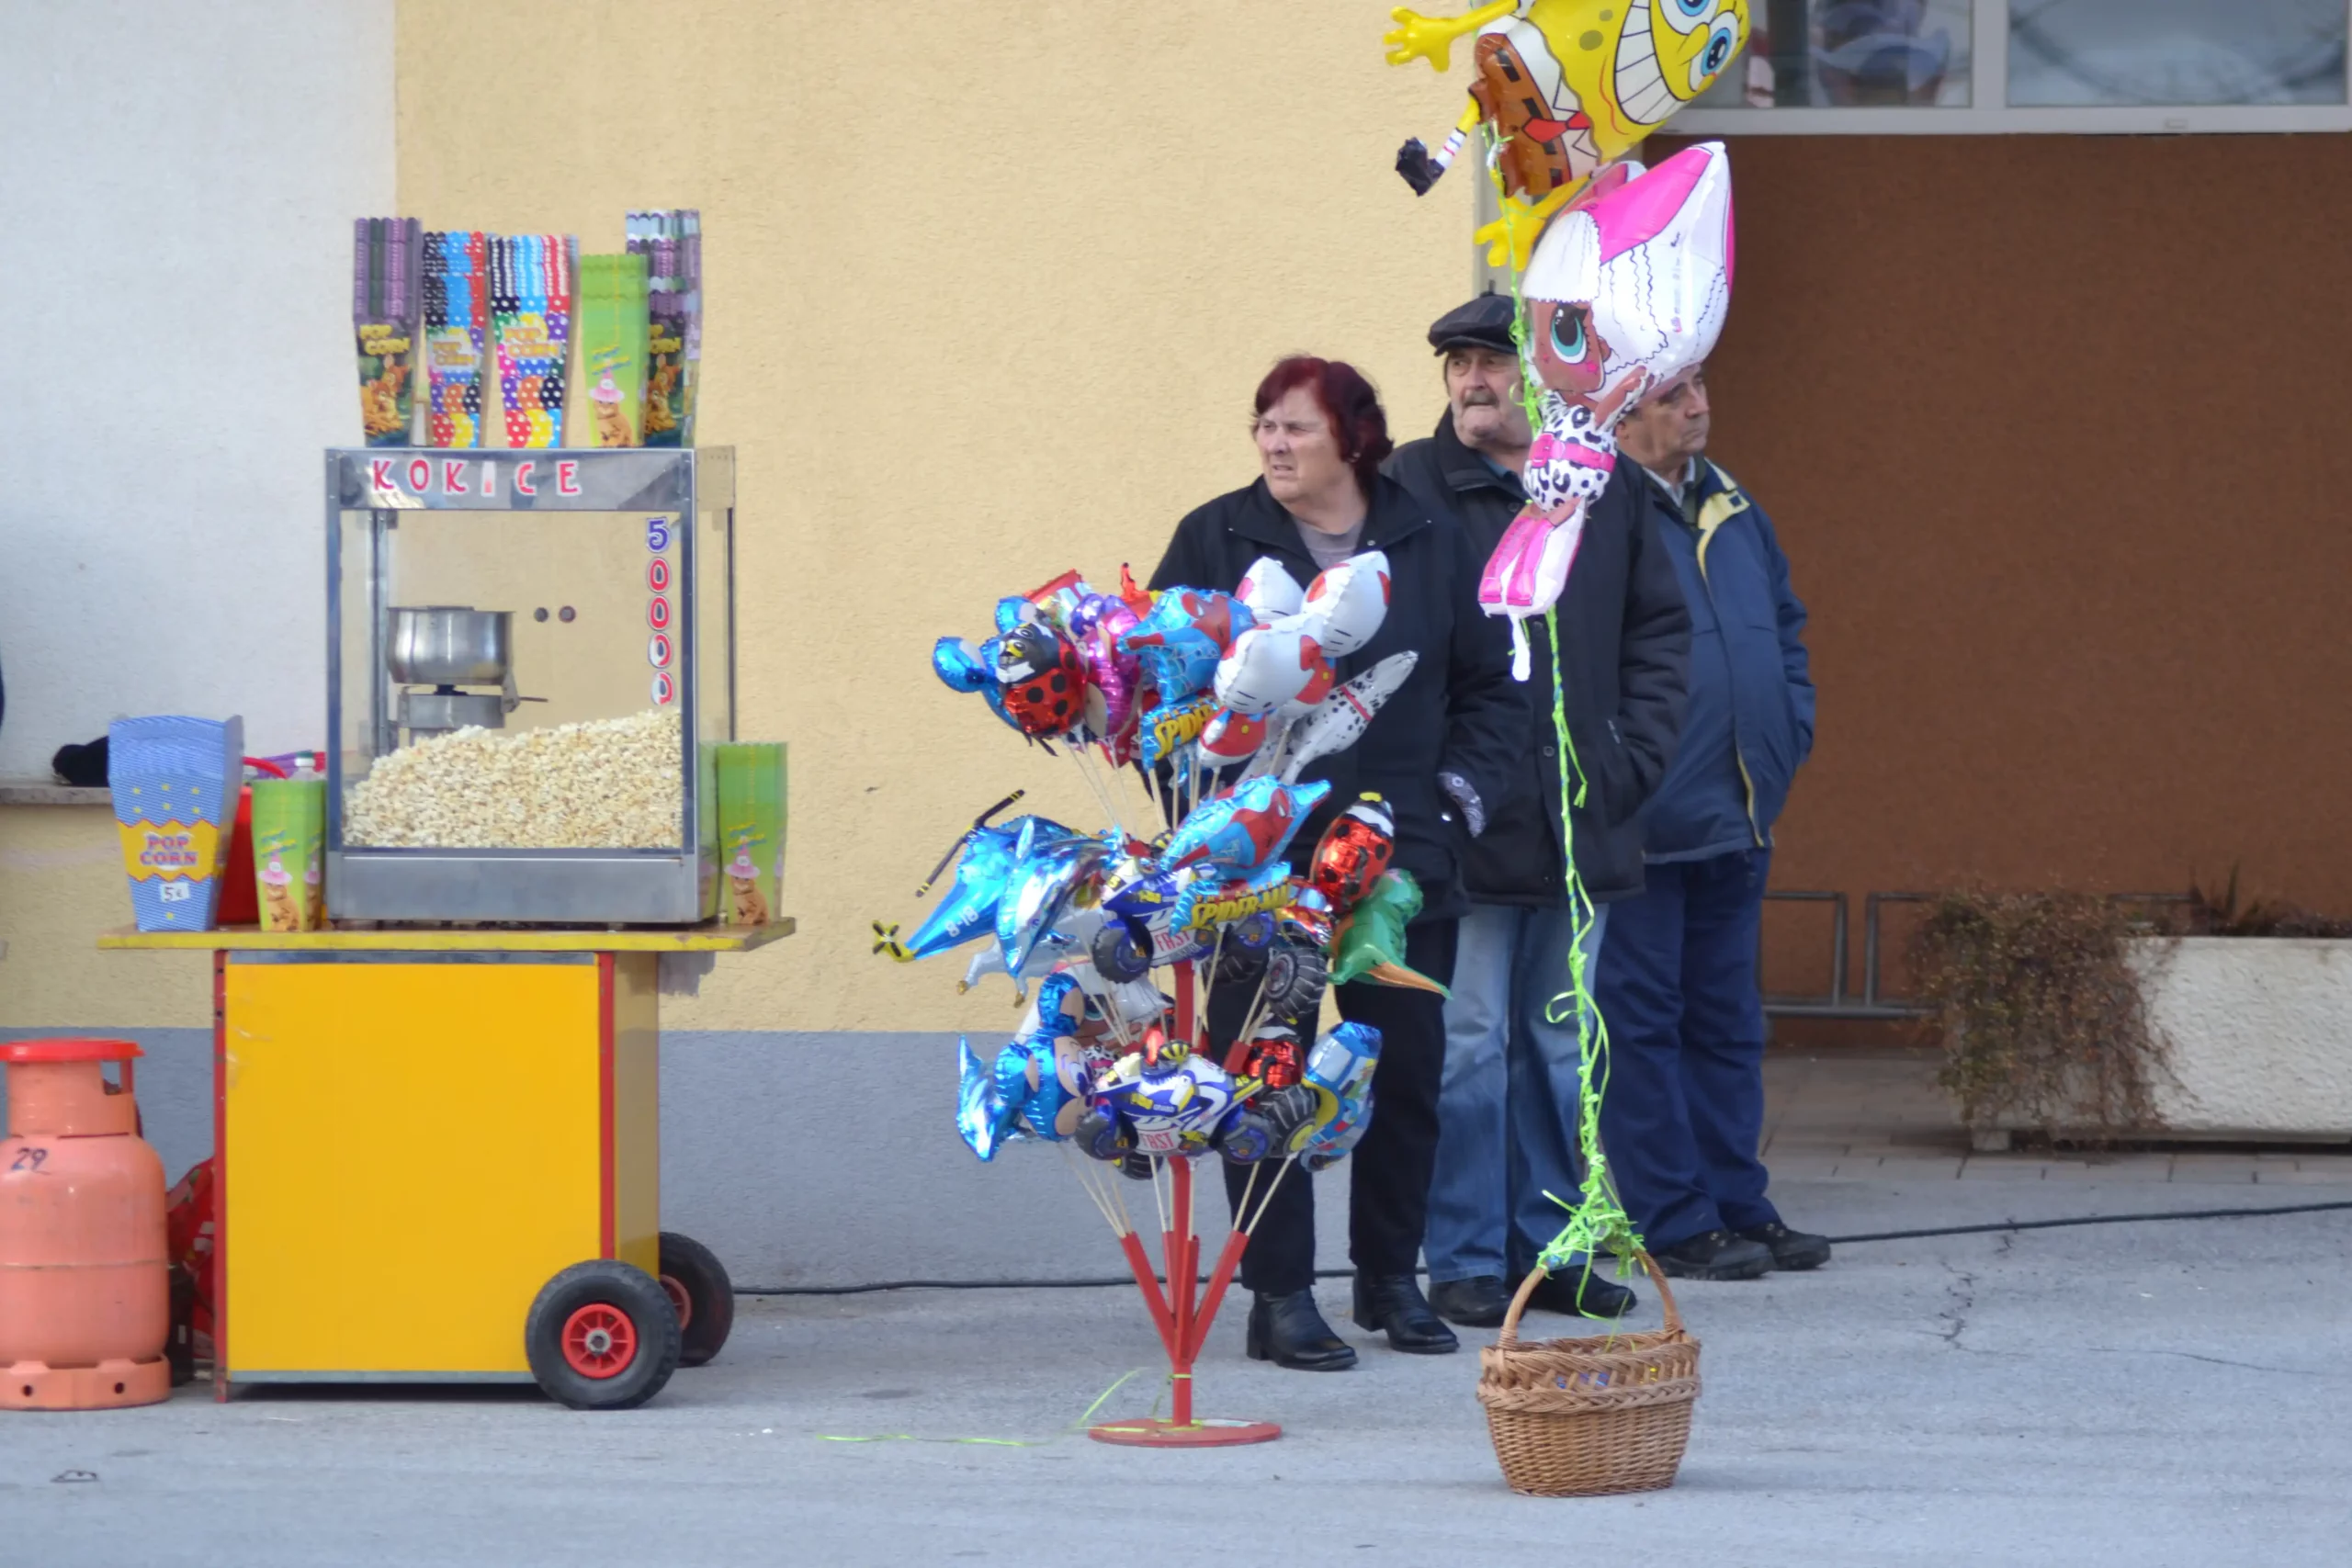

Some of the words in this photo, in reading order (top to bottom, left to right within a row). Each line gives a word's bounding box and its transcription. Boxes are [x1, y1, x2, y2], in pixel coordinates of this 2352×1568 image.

[371, 458, 580, 495] KOKICE
[146, 834, 190, 850] POP
[140, 851, 198, 866] CORN
[10, 1146, 50, 1175] 29
